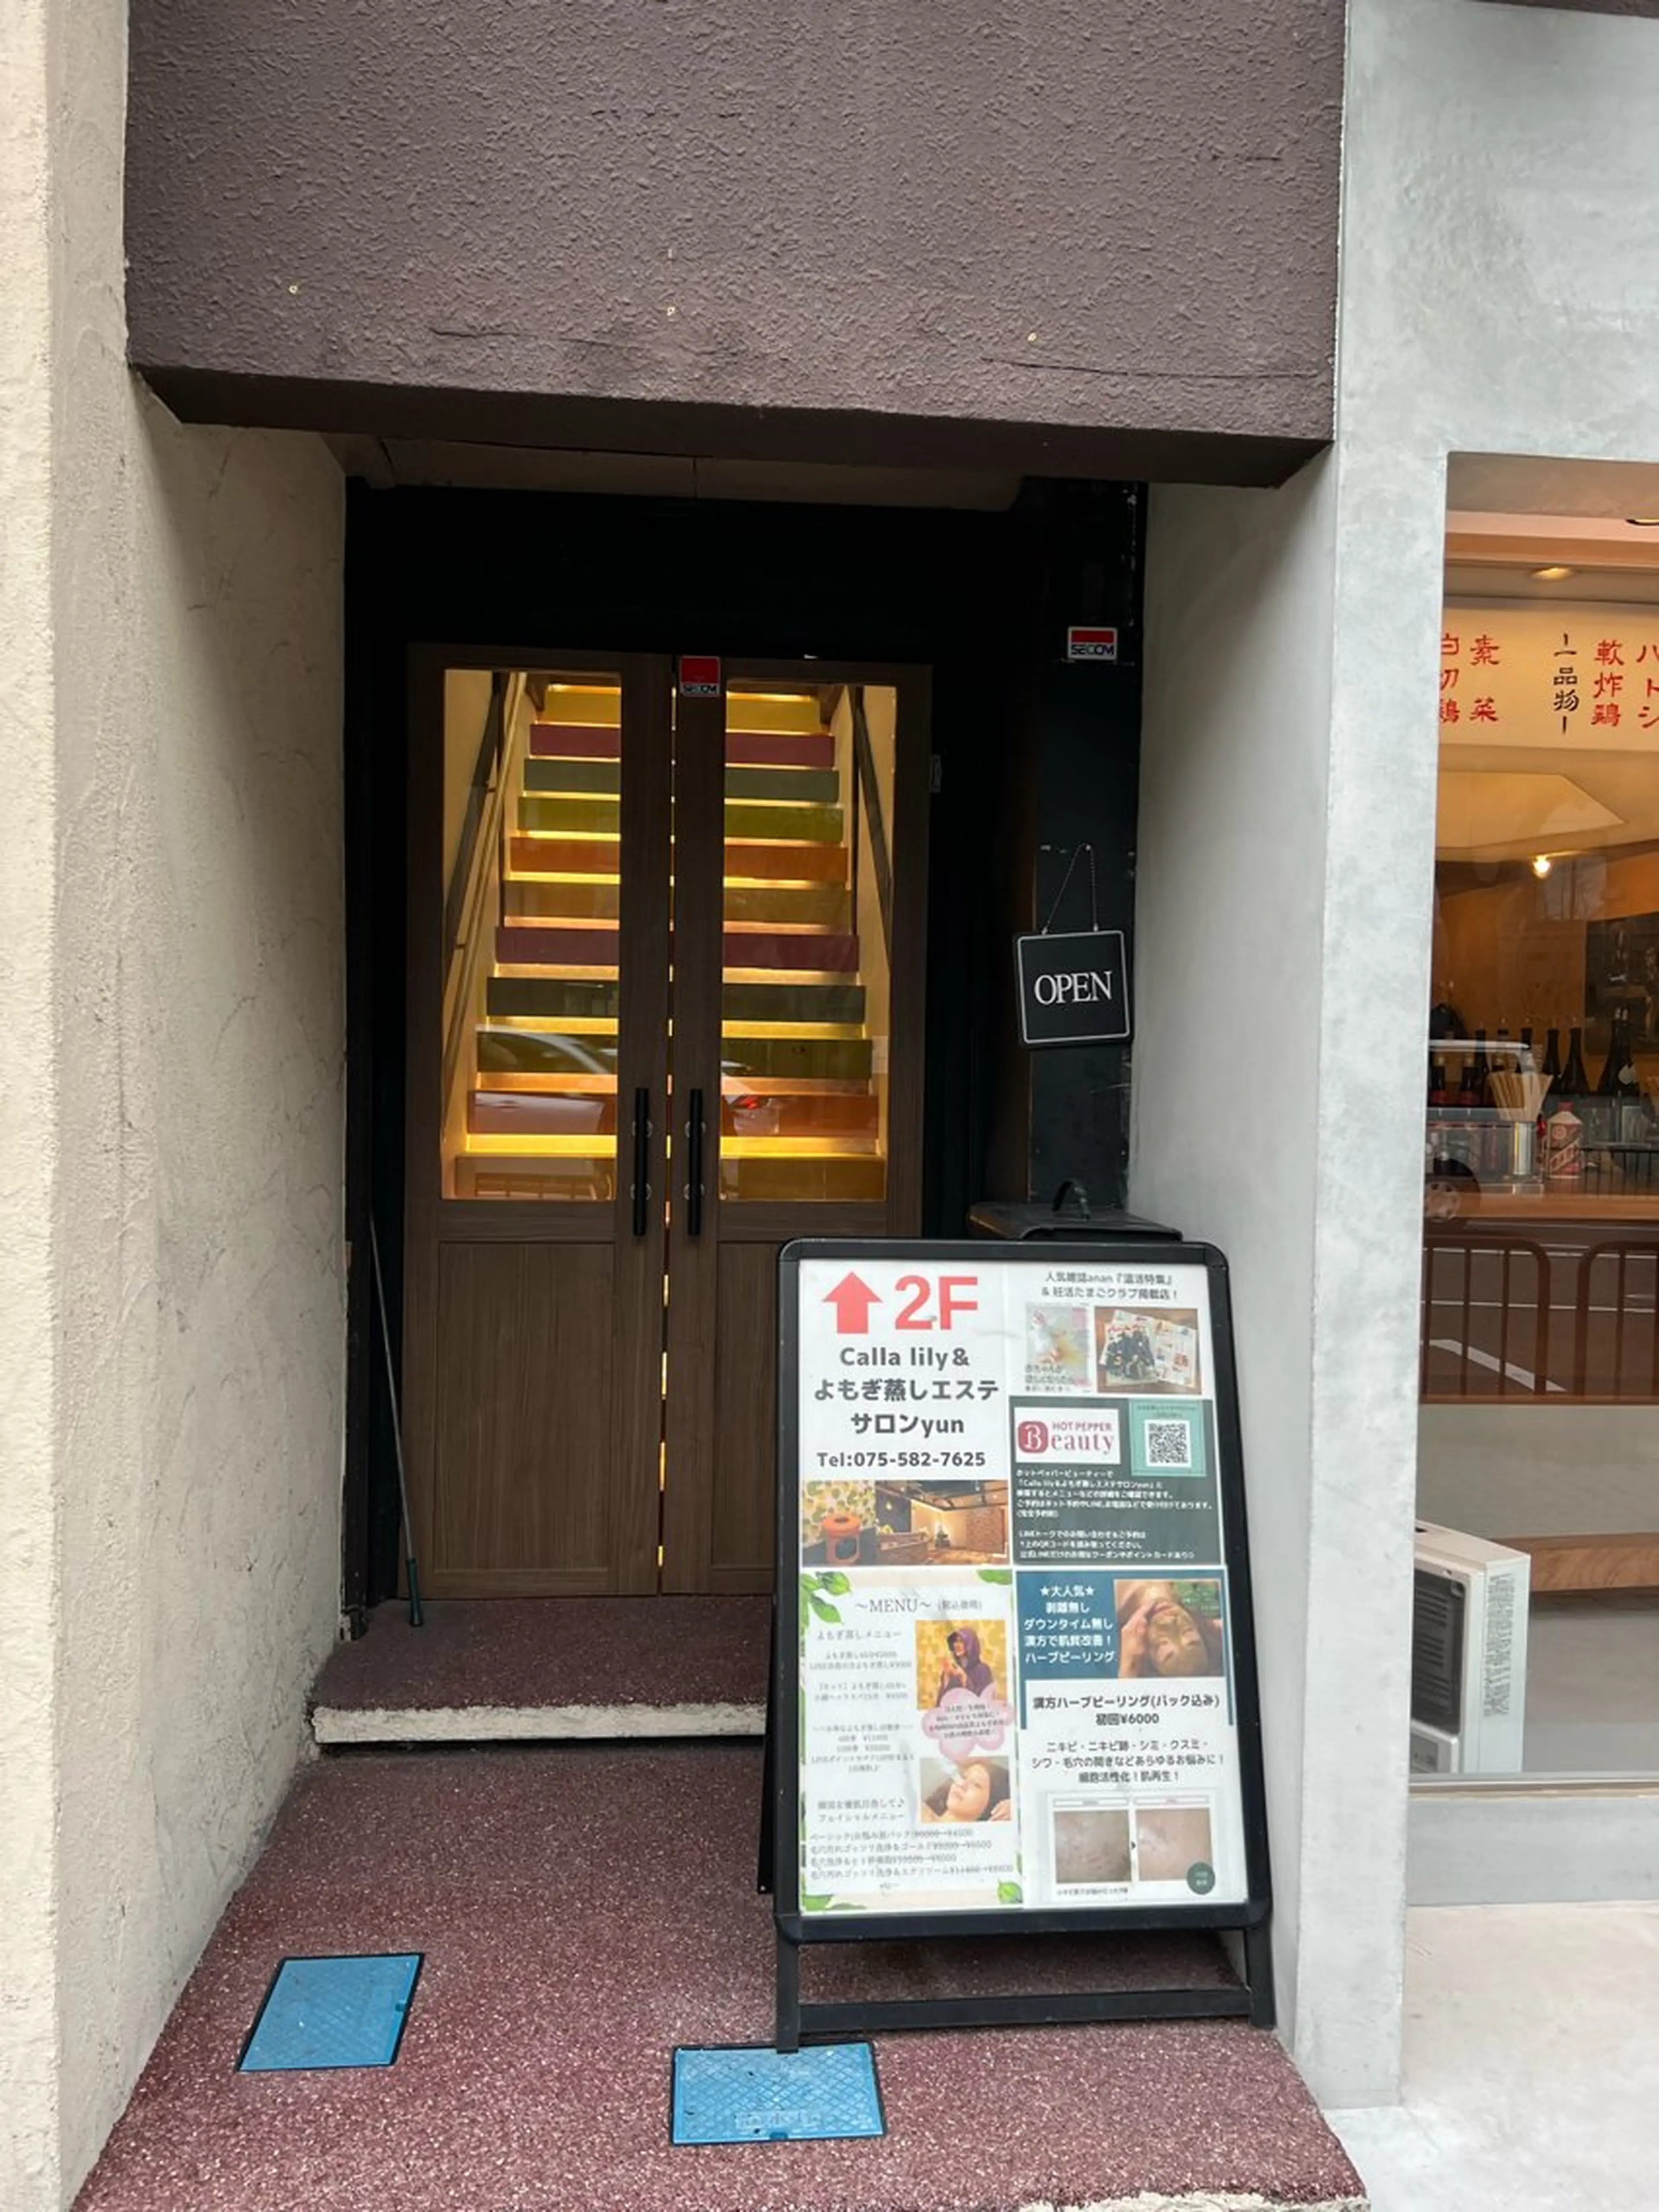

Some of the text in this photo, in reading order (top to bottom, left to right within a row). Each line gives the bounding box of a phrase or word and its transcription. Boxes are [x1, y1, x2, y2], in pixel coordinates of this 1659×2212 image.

[1071, 644, 1114, 656] SECOM
[1034, 970, 1113, 1005] OPEN
[895, 1275, 979, 1331] 2F
[839, 1347, 901, 1367] Calla
[814, 1379, 998, 1402] よもぎ蒸しエステ
[850, 1413, 965, 1438] サロンyun
[817, 1452, 986, 1468] Tel:075-582-7625
[1024, 1618, 1114, 1631] ダウンタイム無し
[1025, 1650, 1116, 1664] ハーブピーリング
